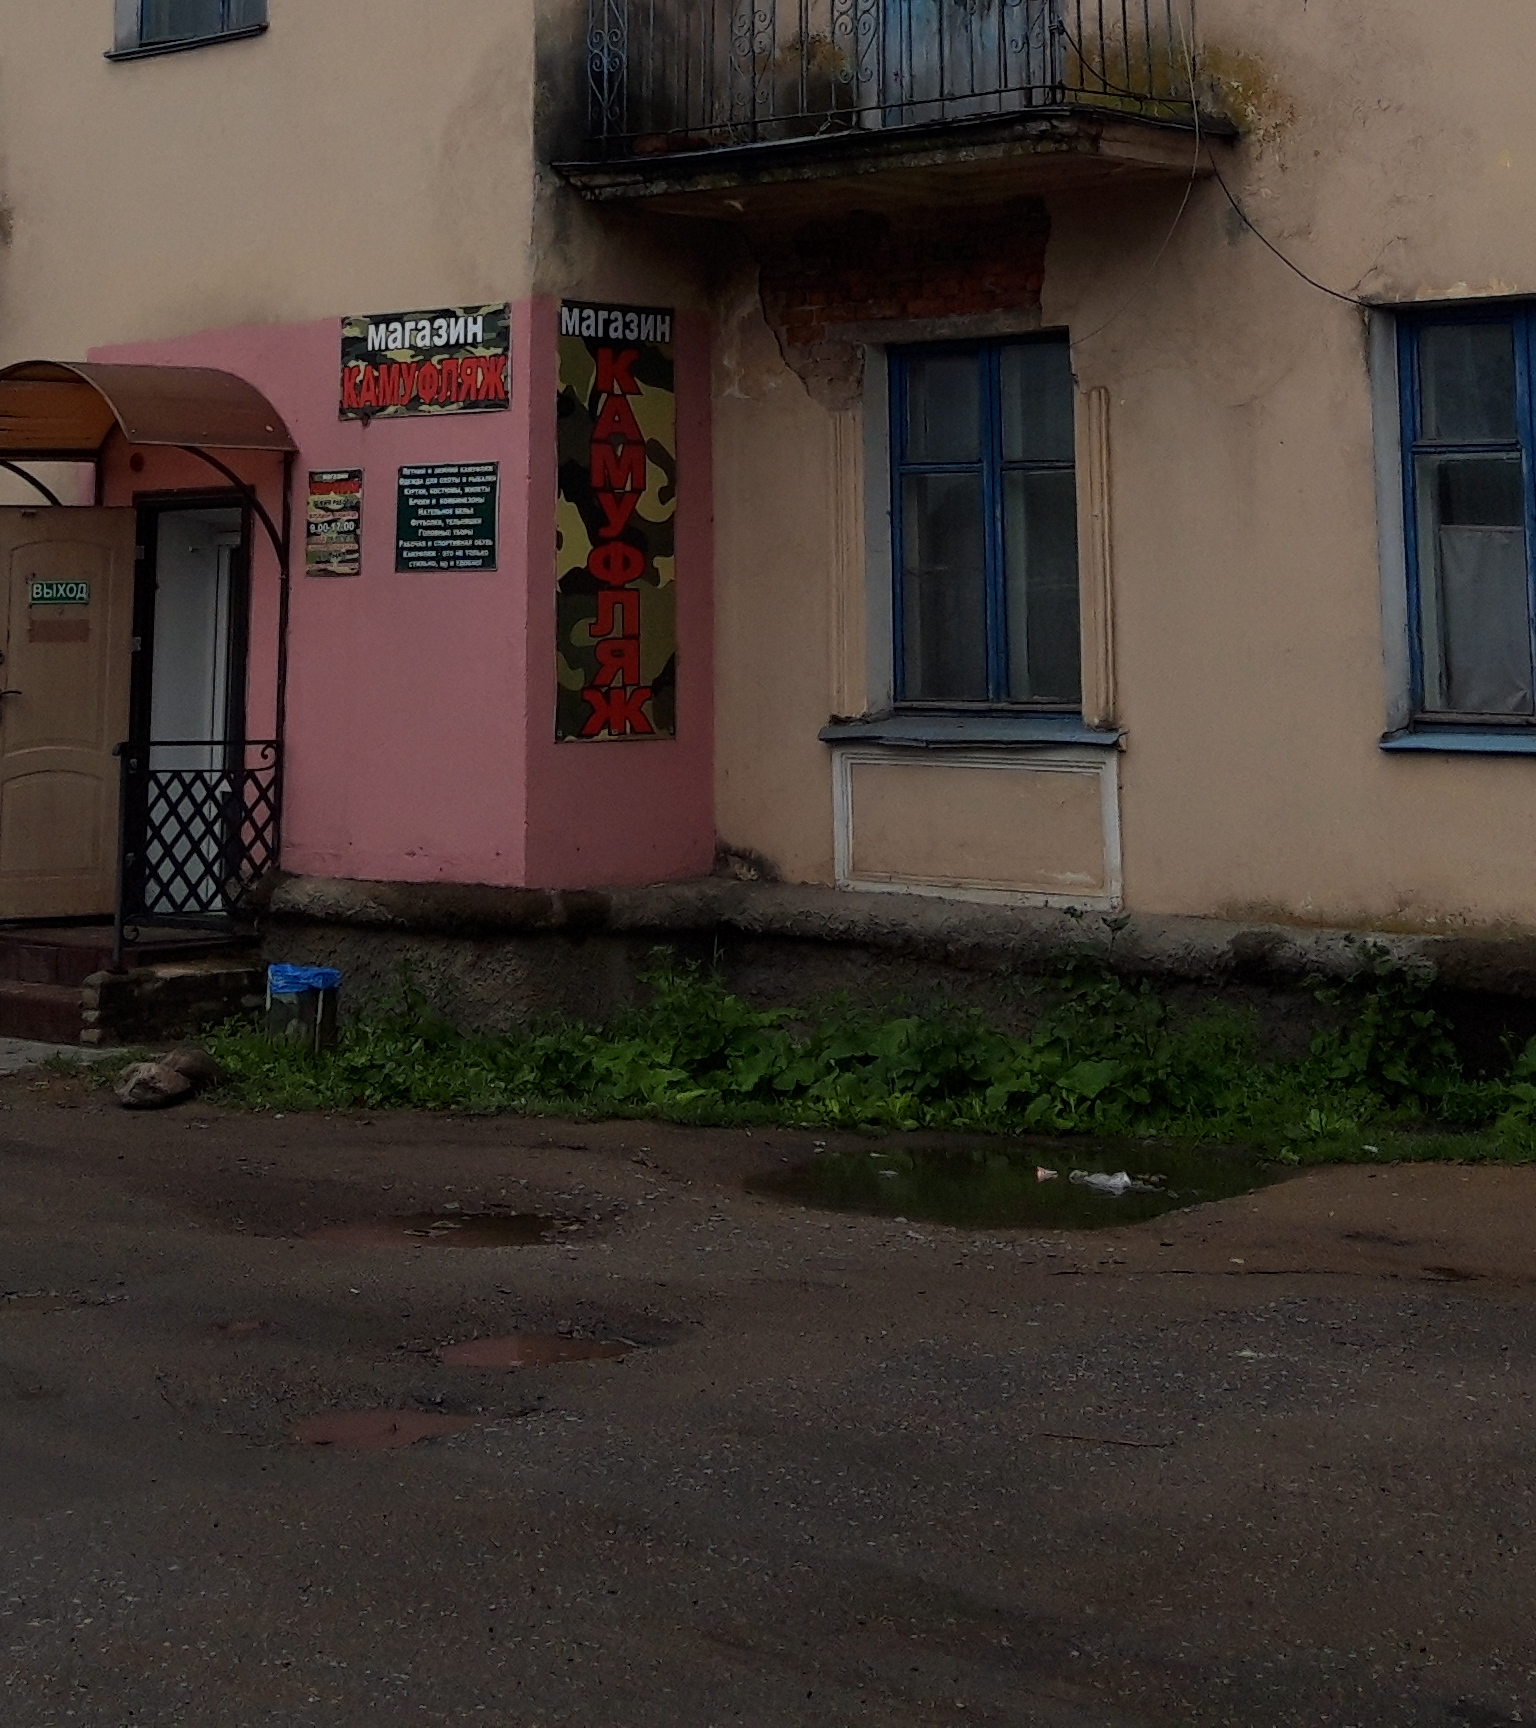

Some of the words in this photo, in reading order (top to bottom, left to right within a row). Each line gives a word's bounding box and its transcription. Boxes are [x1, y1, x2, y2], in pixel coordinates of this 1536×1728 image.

[367, 316, 483, 351] магазин
[561, 307, 671, 343] магазин
[343, 355, 505, 408] КАМУФЛЯЖ
[581, 348, 655, 735] КАМУФЛЯЖ
[33, 584, 87, 600] ВЫХОД
